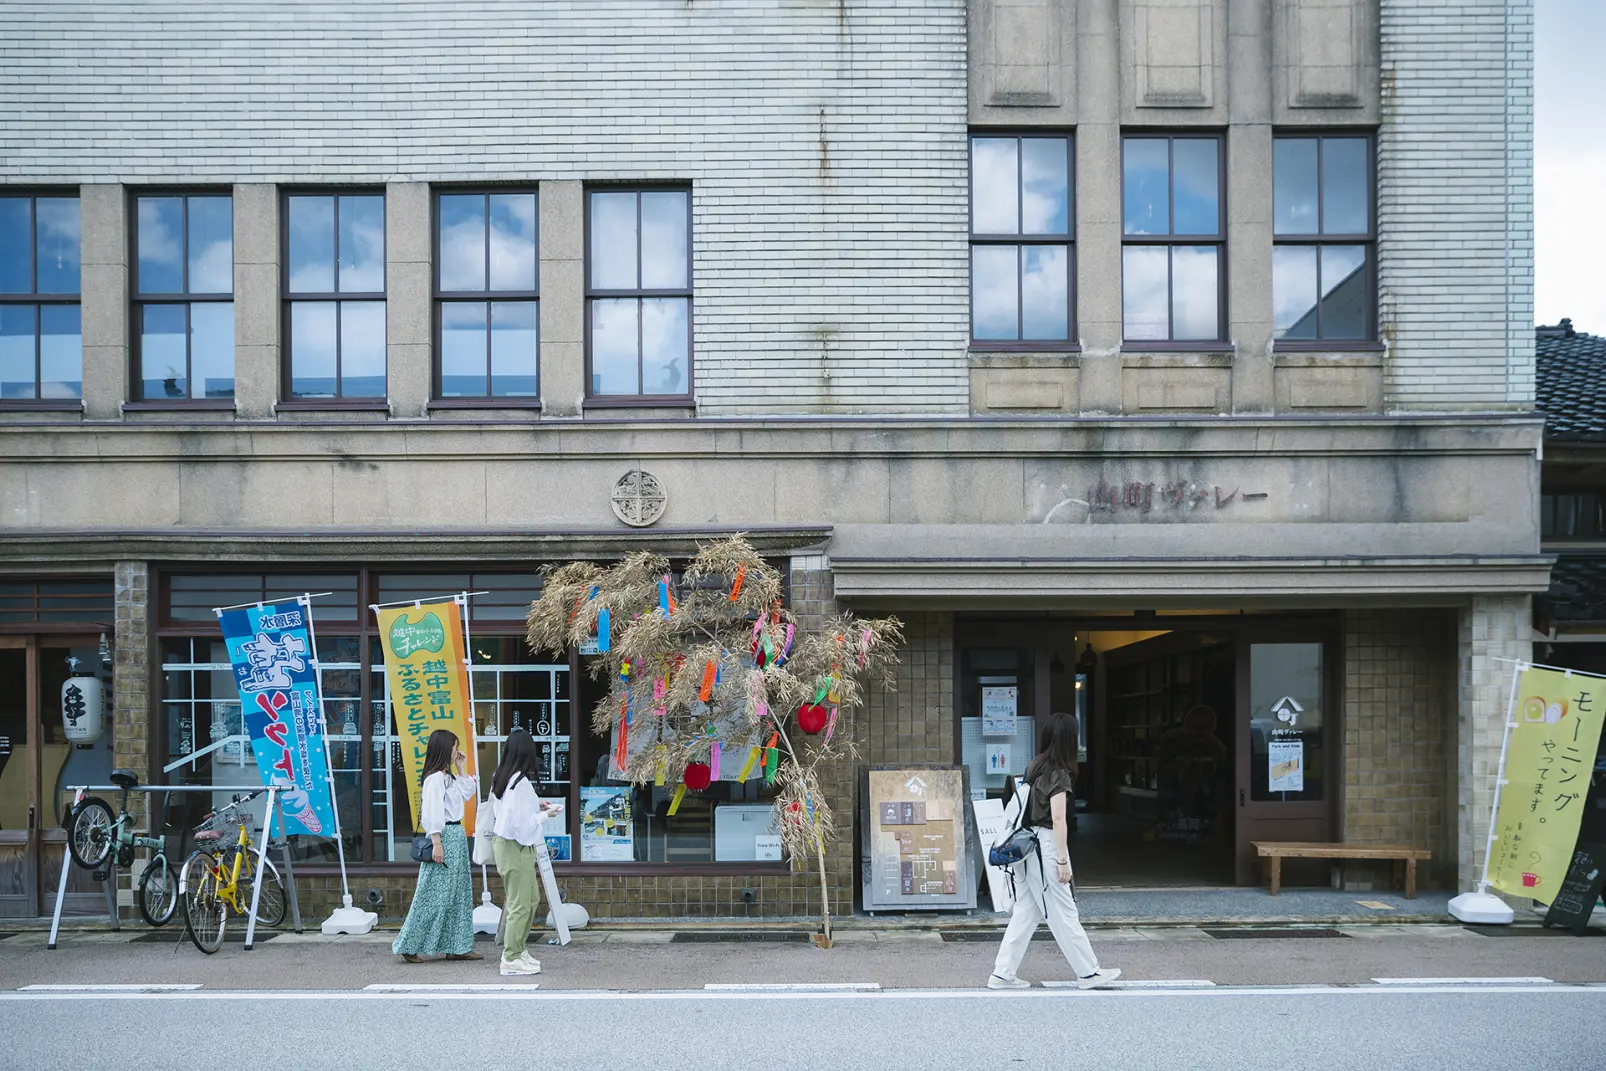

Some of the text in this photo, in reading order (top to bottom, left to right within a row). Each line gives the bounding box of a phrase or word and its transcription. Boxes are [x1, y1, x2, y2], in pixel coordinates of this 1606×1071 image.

[395, 634, 440, 655] チャレンジ
[422, 659, 455, 721] 越中富山
[1530, 739, 1556, 825] やってます。
[1554, 691, 1593, 812] モーニング
